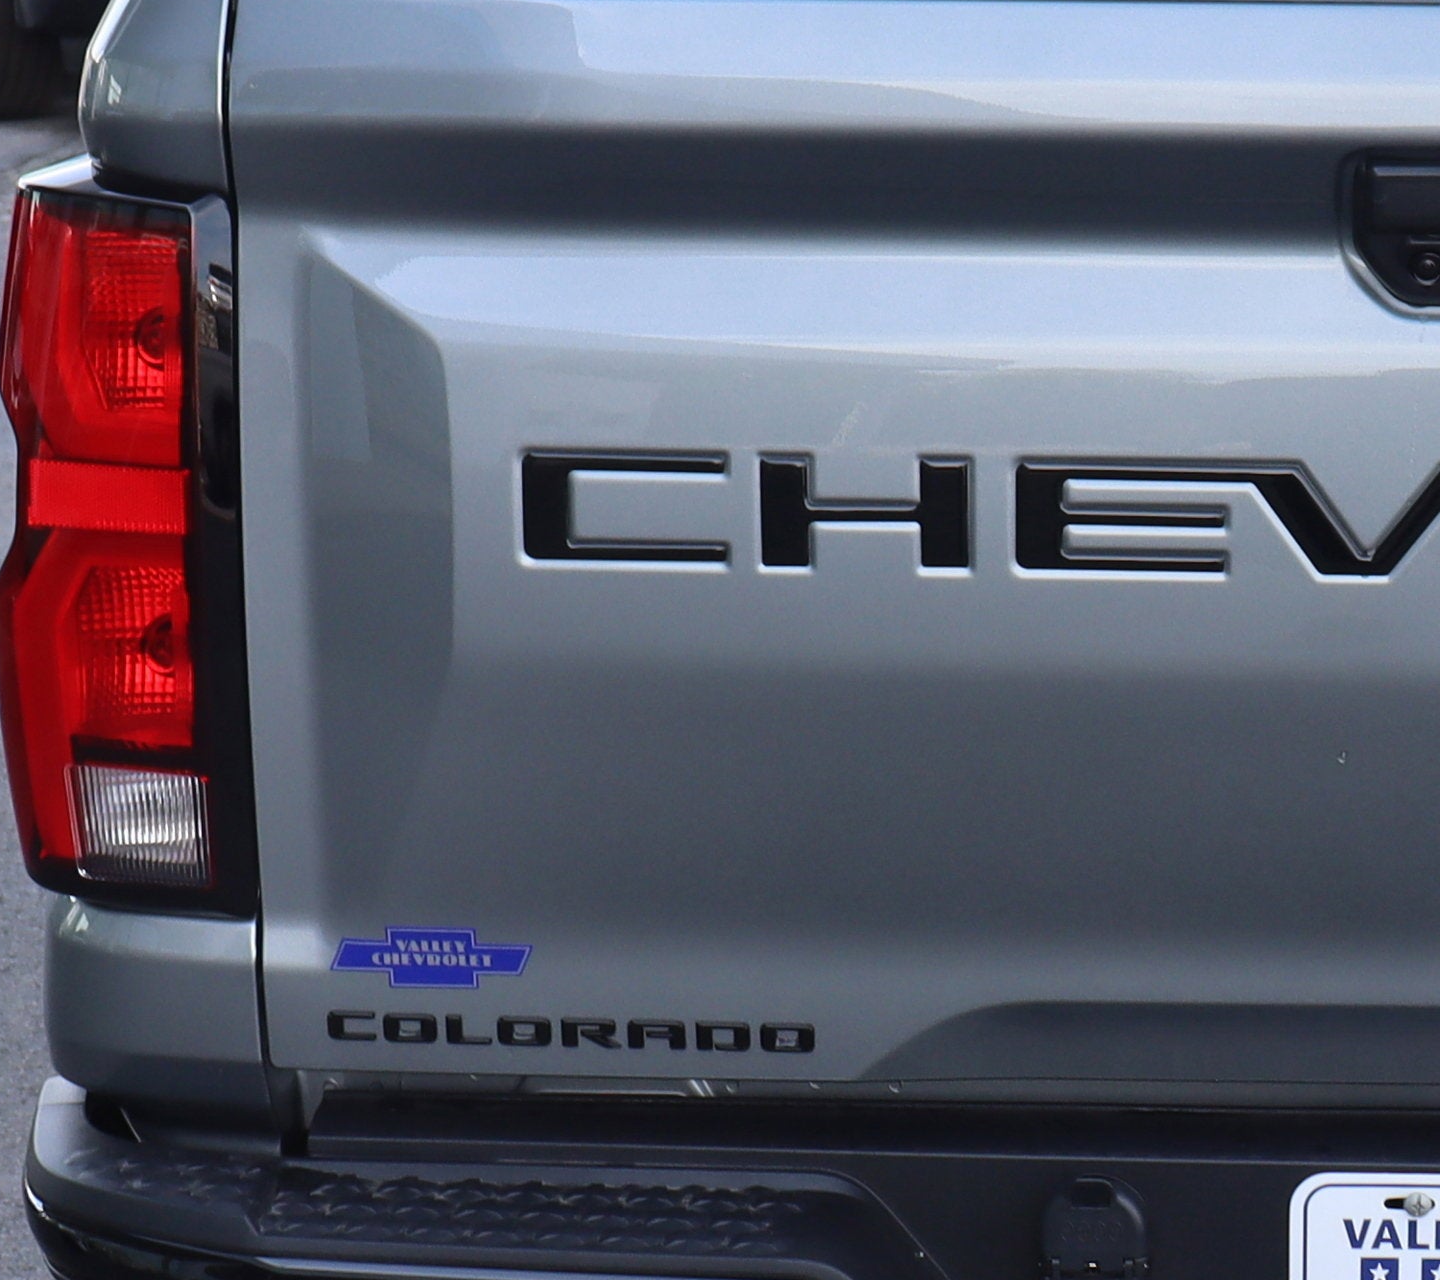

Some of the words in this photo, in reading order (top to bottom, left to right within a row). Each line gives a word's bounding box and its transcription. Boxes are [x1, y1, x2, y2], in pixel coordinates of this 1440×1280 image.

[396, 939, 468, 954] VALLEY
[372, 951, 493, 969] CHEVROLET
[326, 1009, 817, 1053] COLORADO
